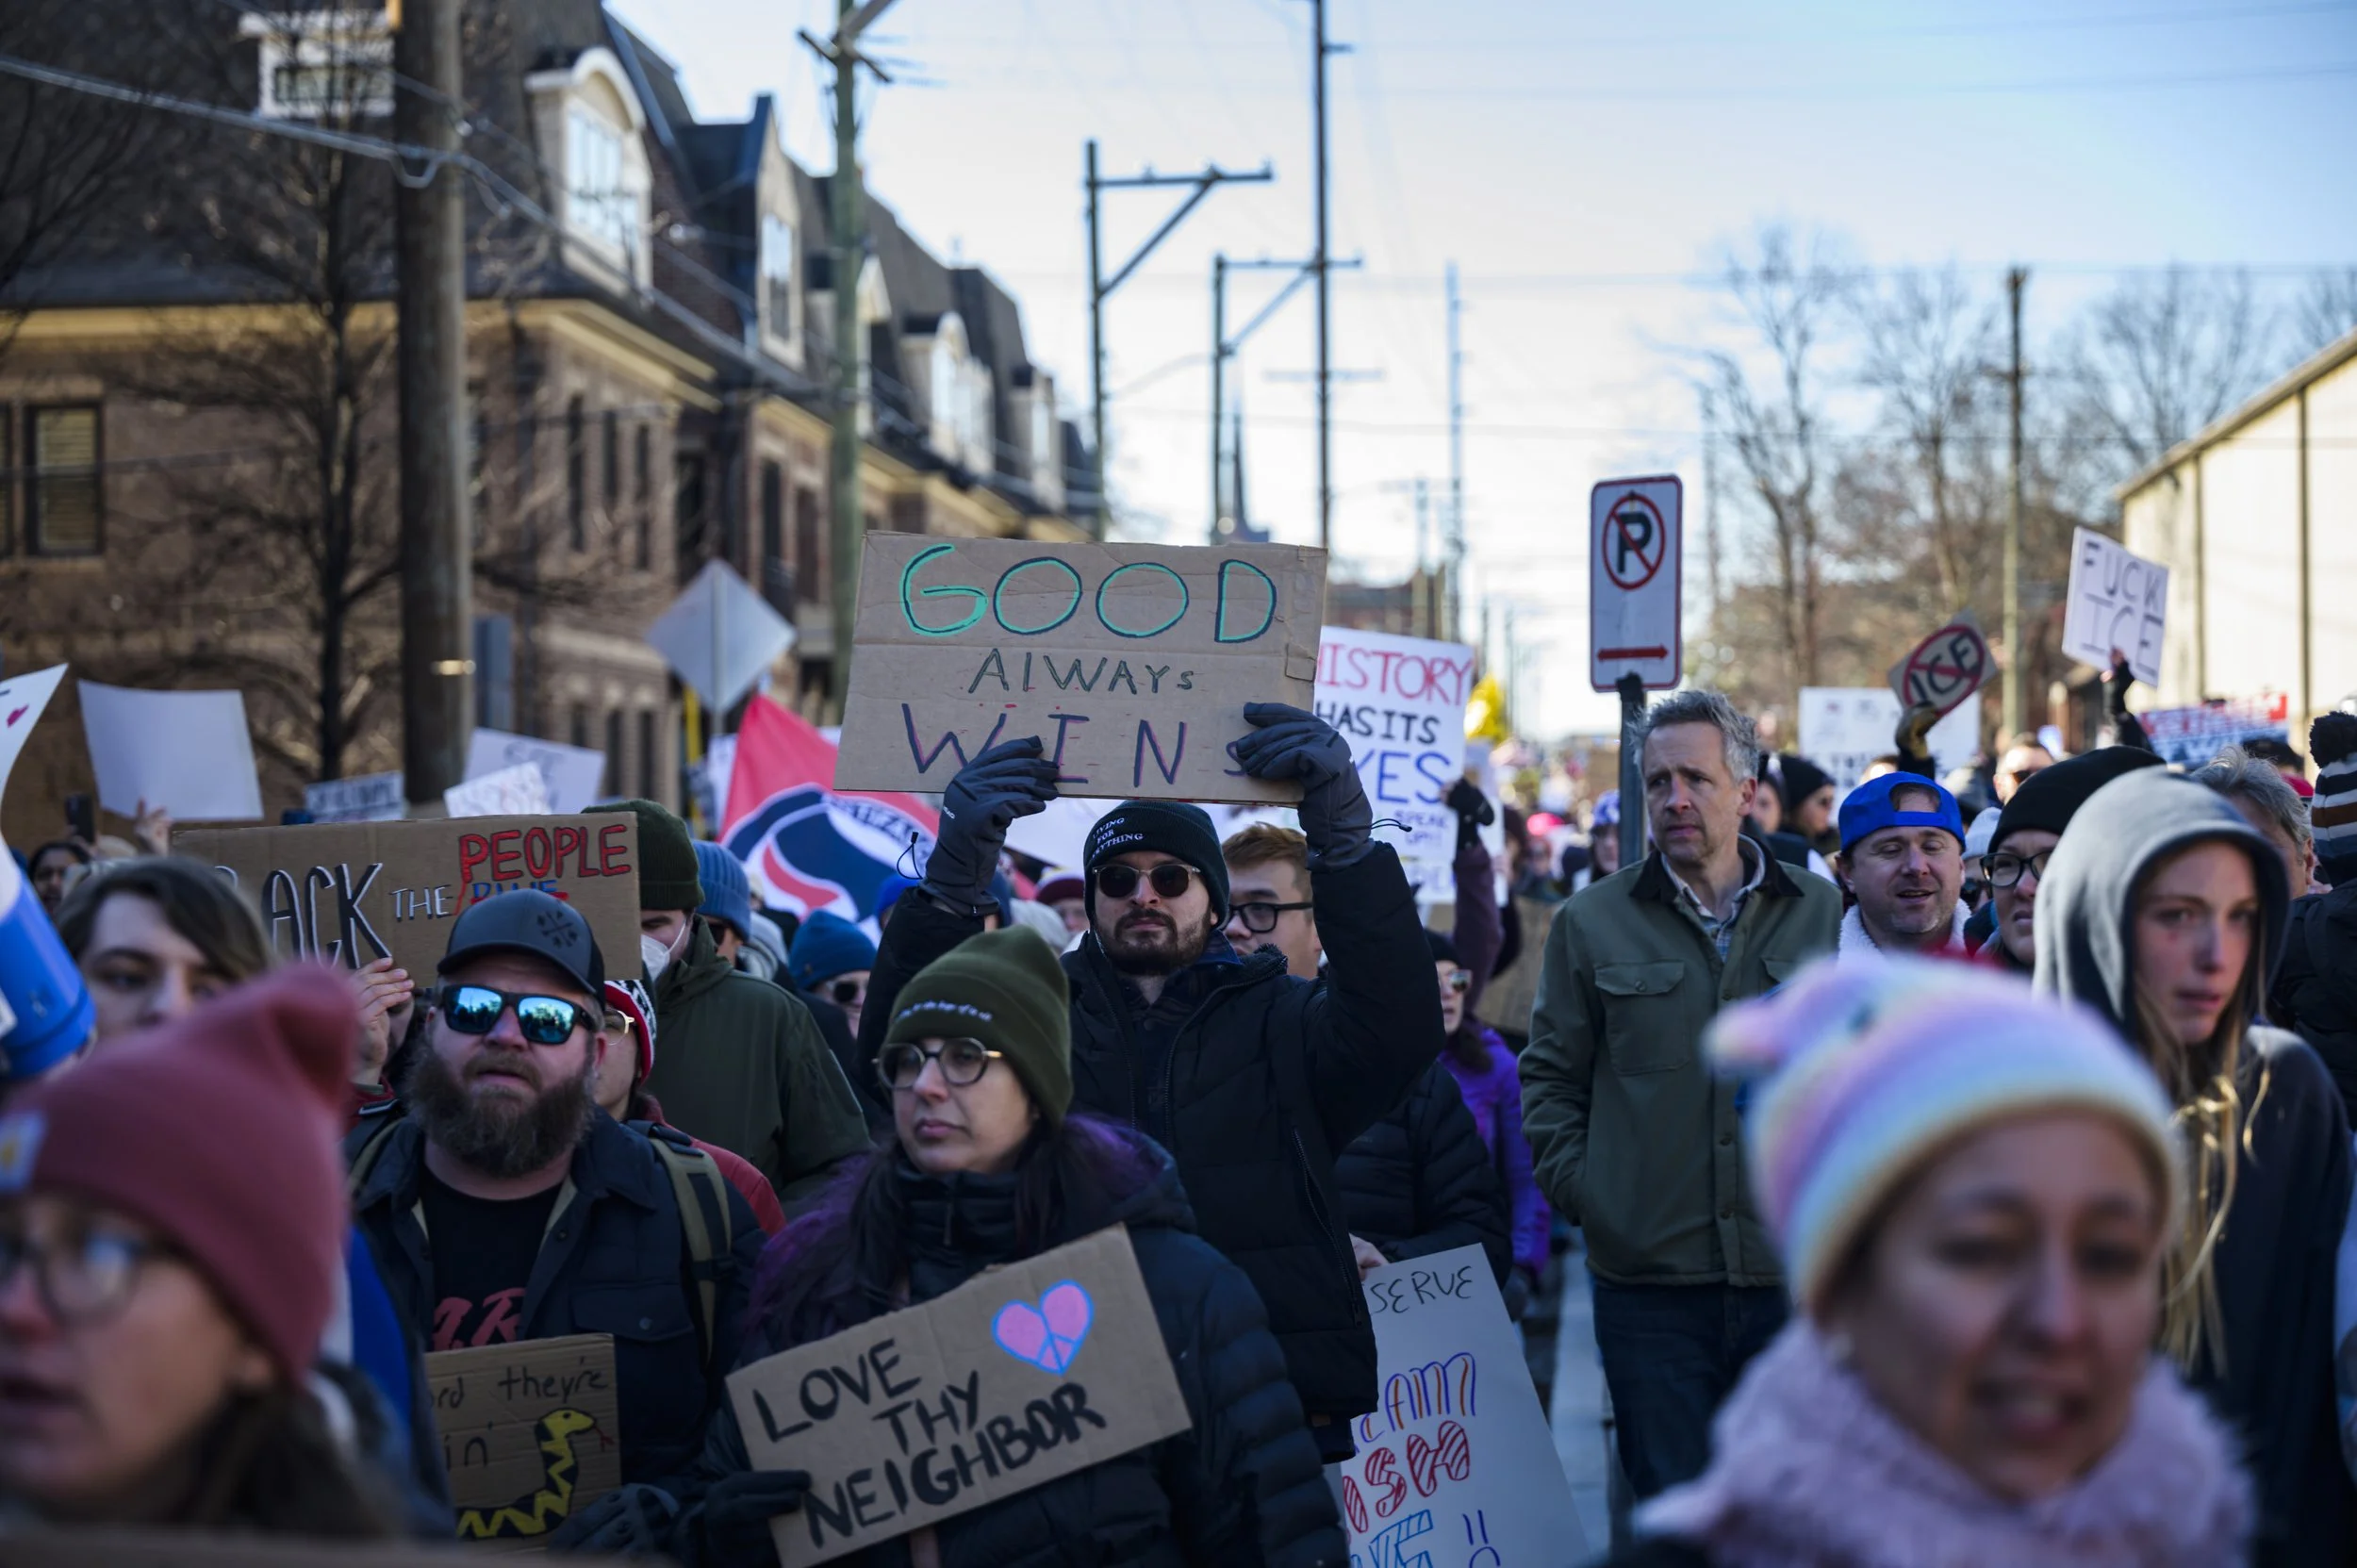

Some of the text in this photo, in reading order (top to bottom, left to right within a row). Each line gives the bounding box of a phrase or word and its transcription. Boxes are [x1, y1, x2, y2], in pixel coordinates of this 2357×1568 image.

[899, 543, 1277, 643] GOOD
[2081, 540, 2161, 612] FUCK
[1910, 629, 1981, 703] ICE
[2081, 592, 2164, 678] ICE
[457, 823, 632, 883] PEOPLE
[215, 862, 392, 970] ACK
[388, 883, 455, 922] THE
[1362, 1265, 1473, 1313] SERVE
[498, 1356, 609, 1404] they're
[751, 1338, 922, 1444] LOVE
[871, 1370, 980, 1456] THY
[800, 1382, 1107, 1550] NEIGHBOR
